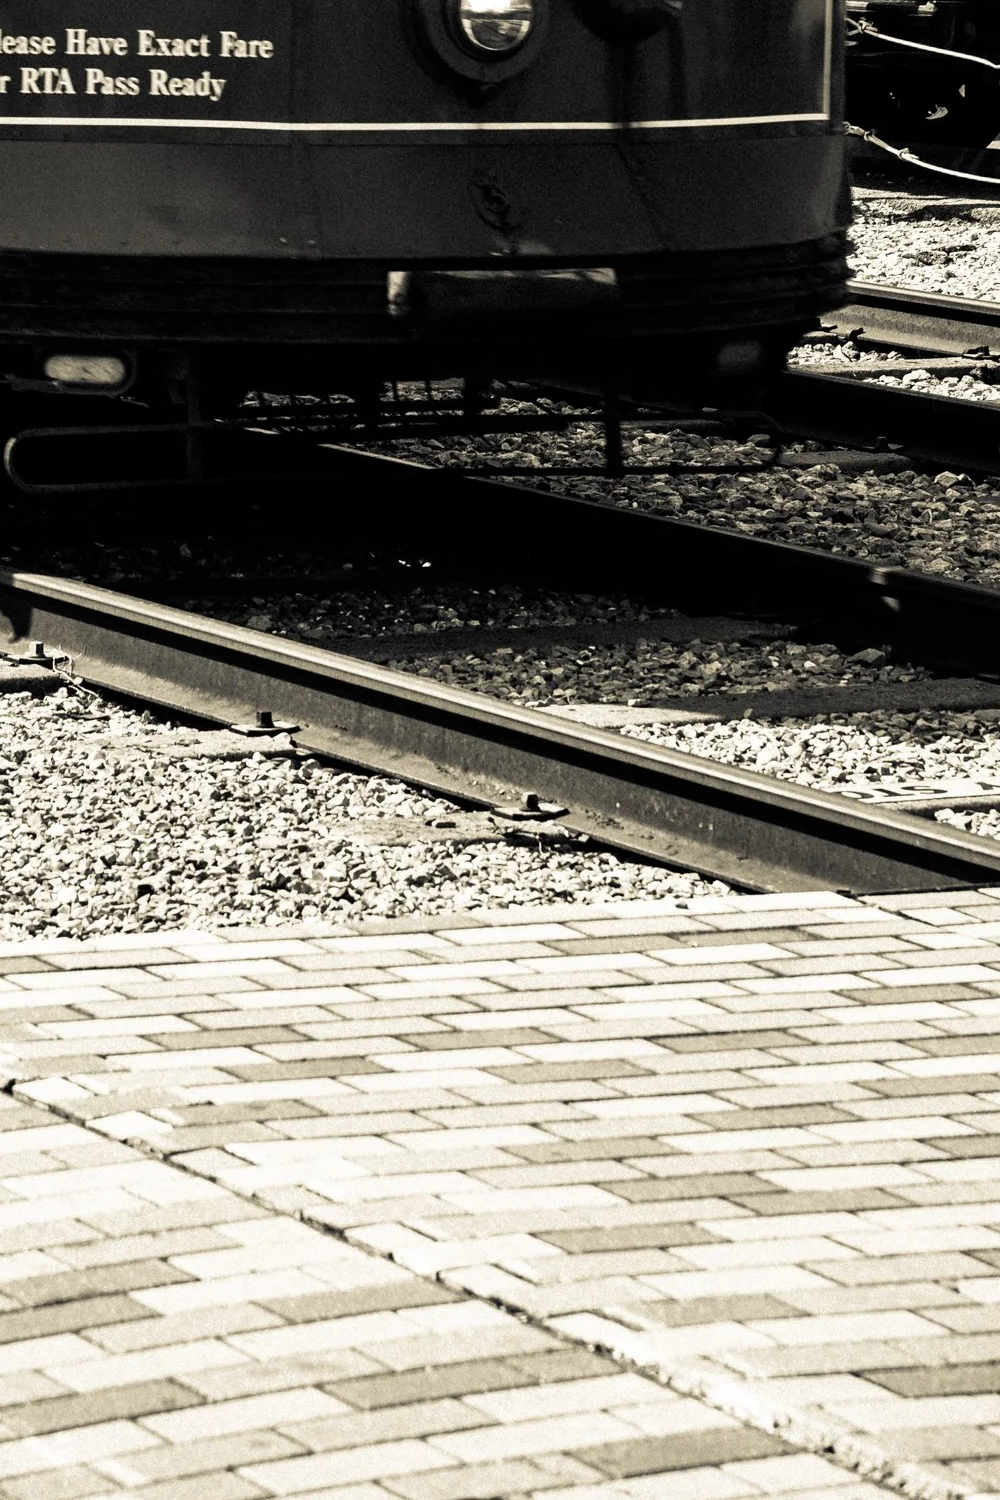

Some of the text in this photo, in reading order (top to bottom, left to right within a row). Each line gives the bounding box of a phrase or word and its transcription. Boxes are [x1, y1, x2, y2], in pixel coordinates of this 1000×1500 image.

[65, 28, 129, 56] Have
[137, 29, 211, 58] Exact
[219, 30, 274, 59] Fare
[19, 67, 77, 95] RTA
[85, 67, 141, 96] Pass
[148, 68, 227, 102] Ready
